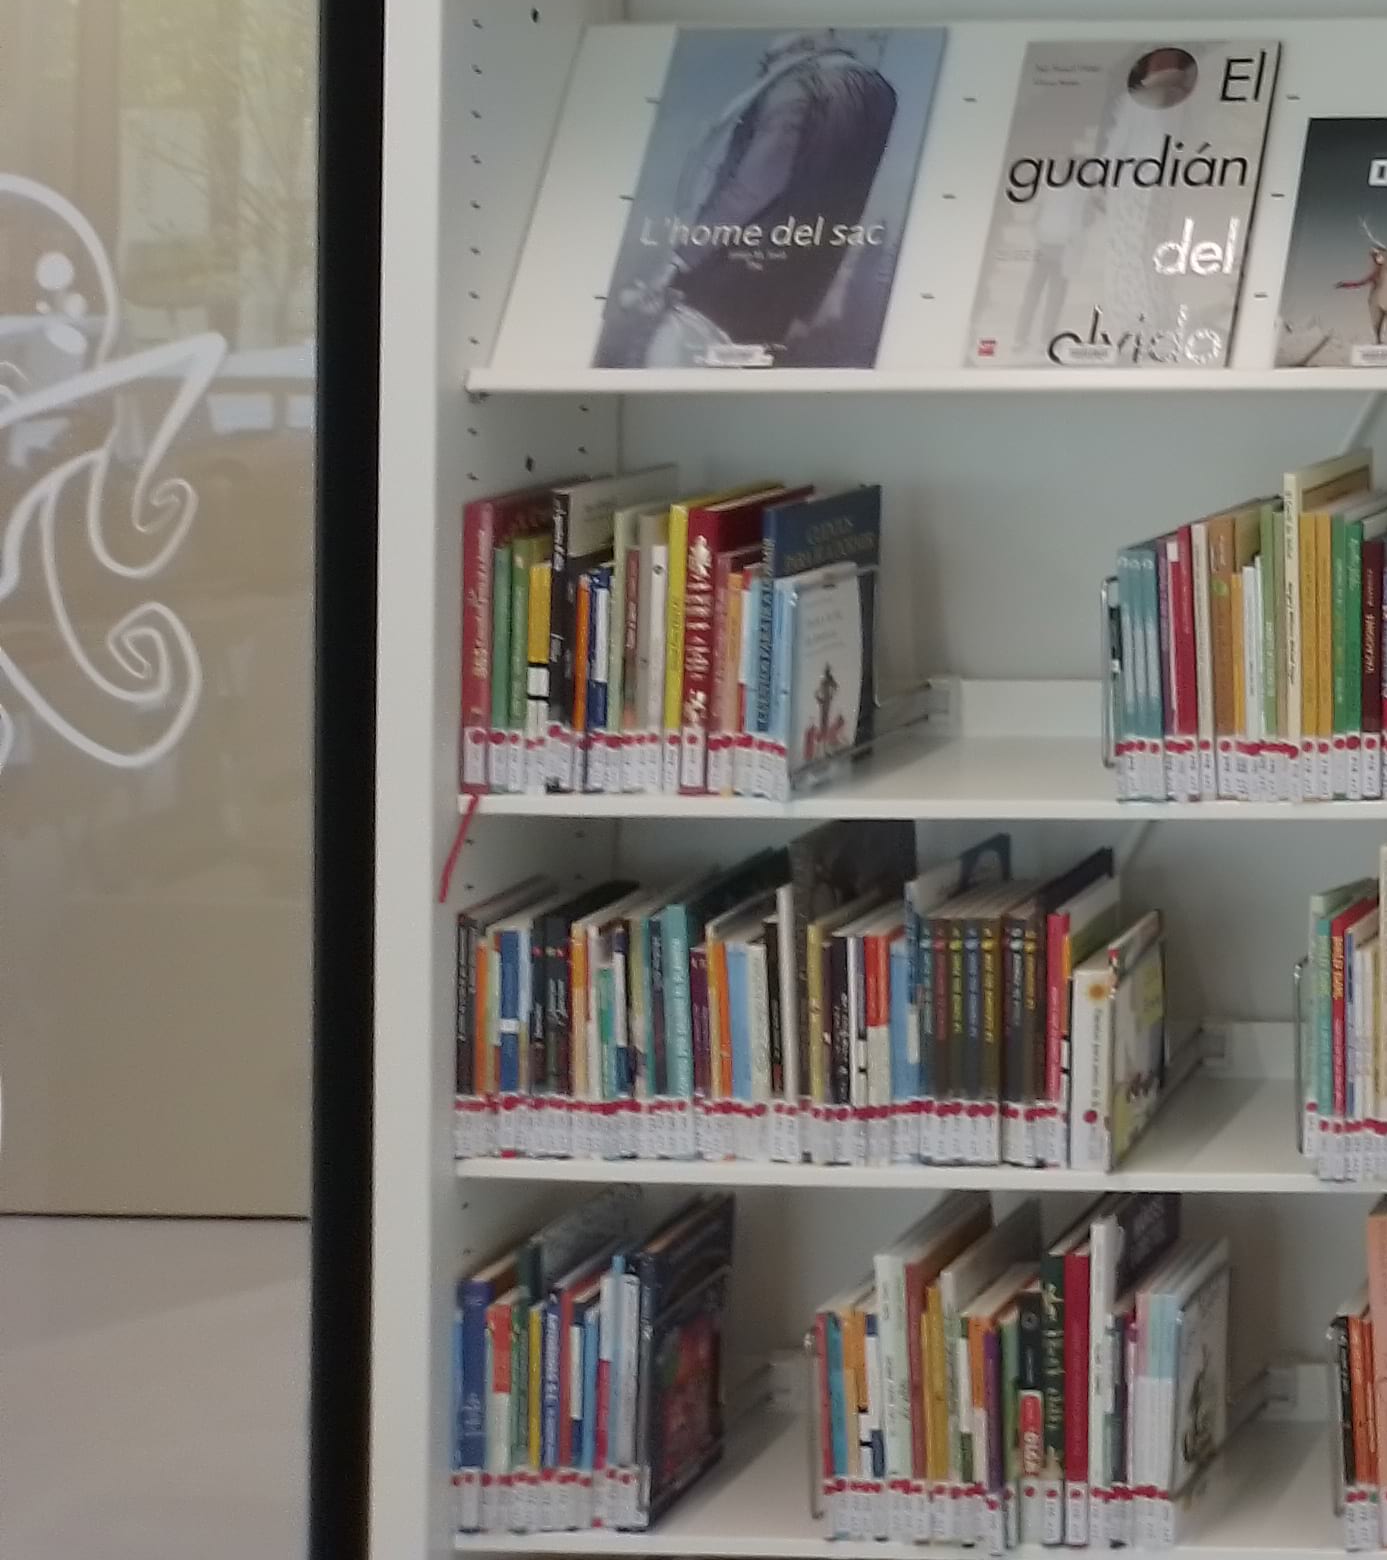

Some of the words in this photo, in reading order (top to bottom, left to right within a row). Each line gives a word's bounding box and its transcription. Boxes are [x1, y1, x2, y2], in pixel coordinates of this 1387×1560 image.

[1218, 50, 1267, 102] El
[1005, 134, 1249, 203] guardián
[640, 216, 763, 247] L'home
[770, 215, 825, 247] del
[829, 224, 886, 246] sac
[1153, 216, 1240, 276] del
